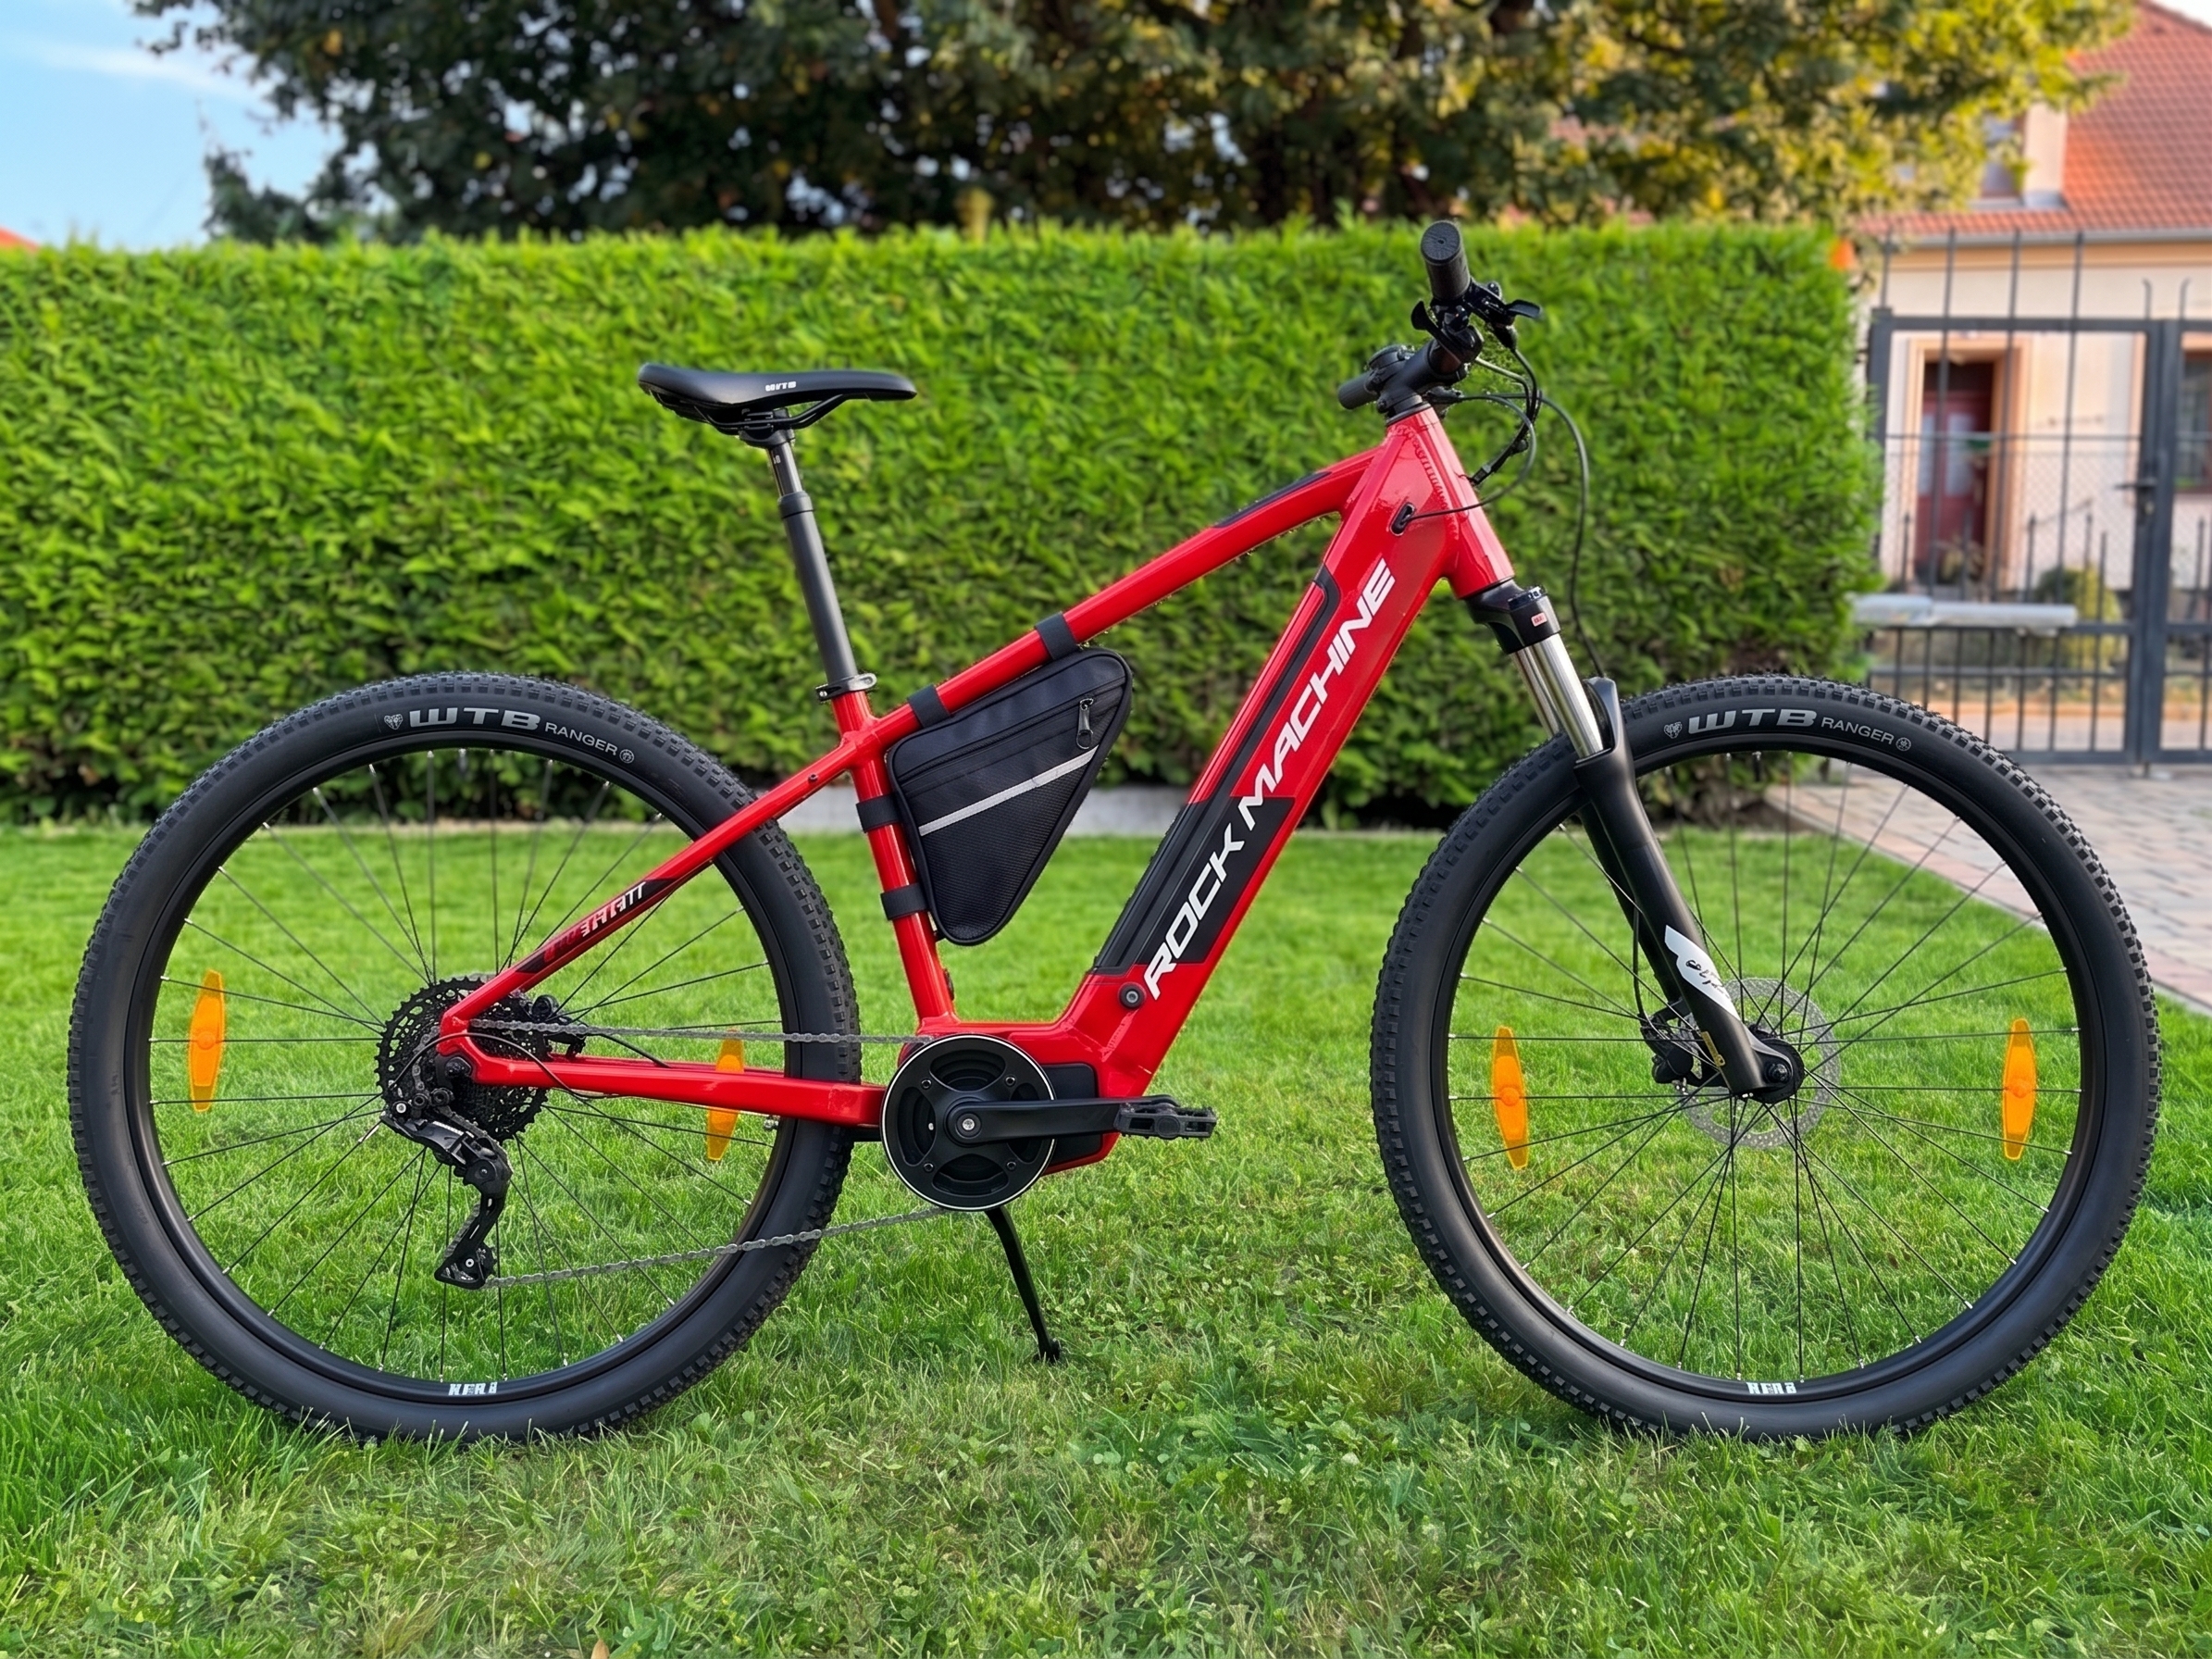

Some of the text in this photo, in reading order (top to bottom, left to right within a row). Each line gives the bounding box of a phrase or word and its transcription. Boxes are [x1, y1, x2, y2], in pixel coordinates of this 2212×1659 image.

[409, 707, 618, 756] WTB RANGER
[1688, 708, 1895, 744] WTB RANGER
[1143, 557, 1396, 1000] ROCK MACHINE
